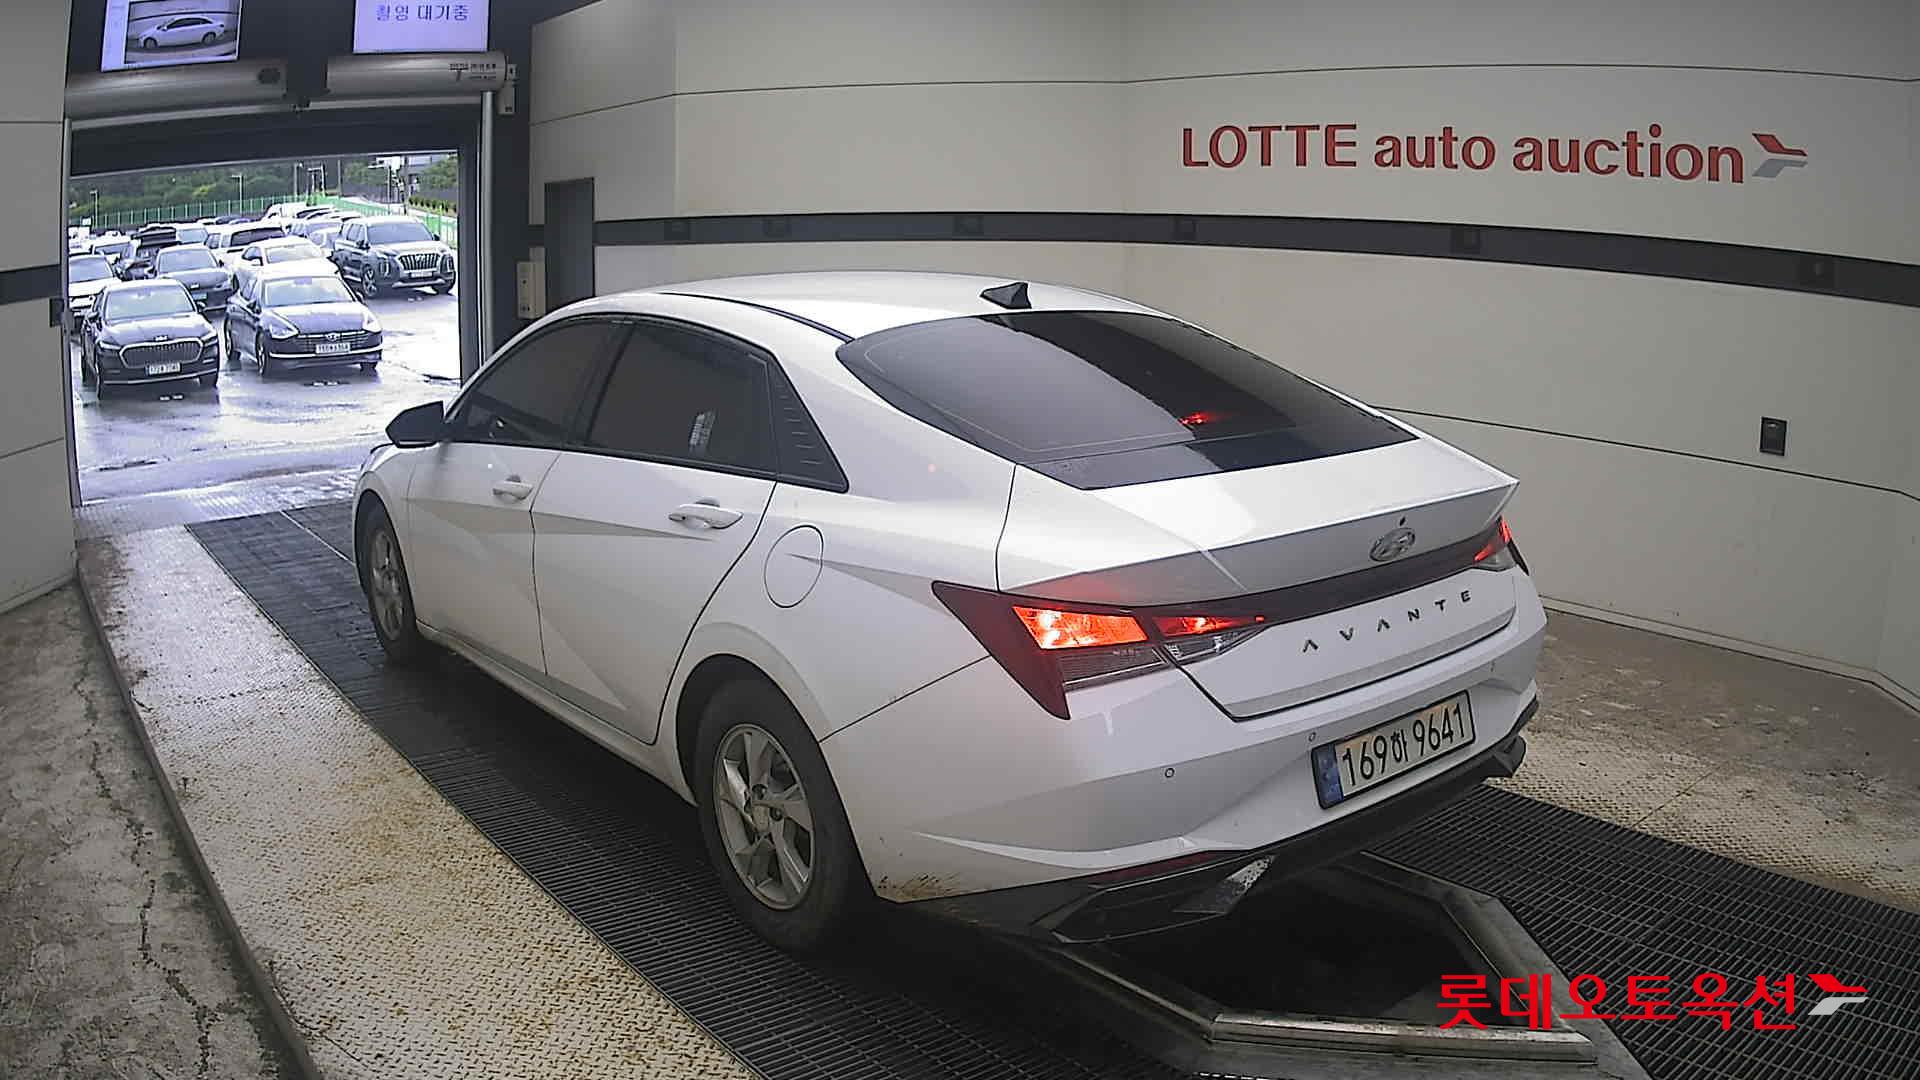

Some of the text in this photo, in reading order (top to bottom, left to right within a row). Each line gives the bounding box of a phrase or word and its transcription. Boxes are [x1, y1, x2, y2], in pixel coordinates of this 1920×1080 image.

[417, 4, 469, 21] 대기중
[1182, 123, 1744, 184] LOTTE auto auction
[1302, 589, 1472, 653] AVANTE
[1342, 703, 1465, 786] 169하 9641
